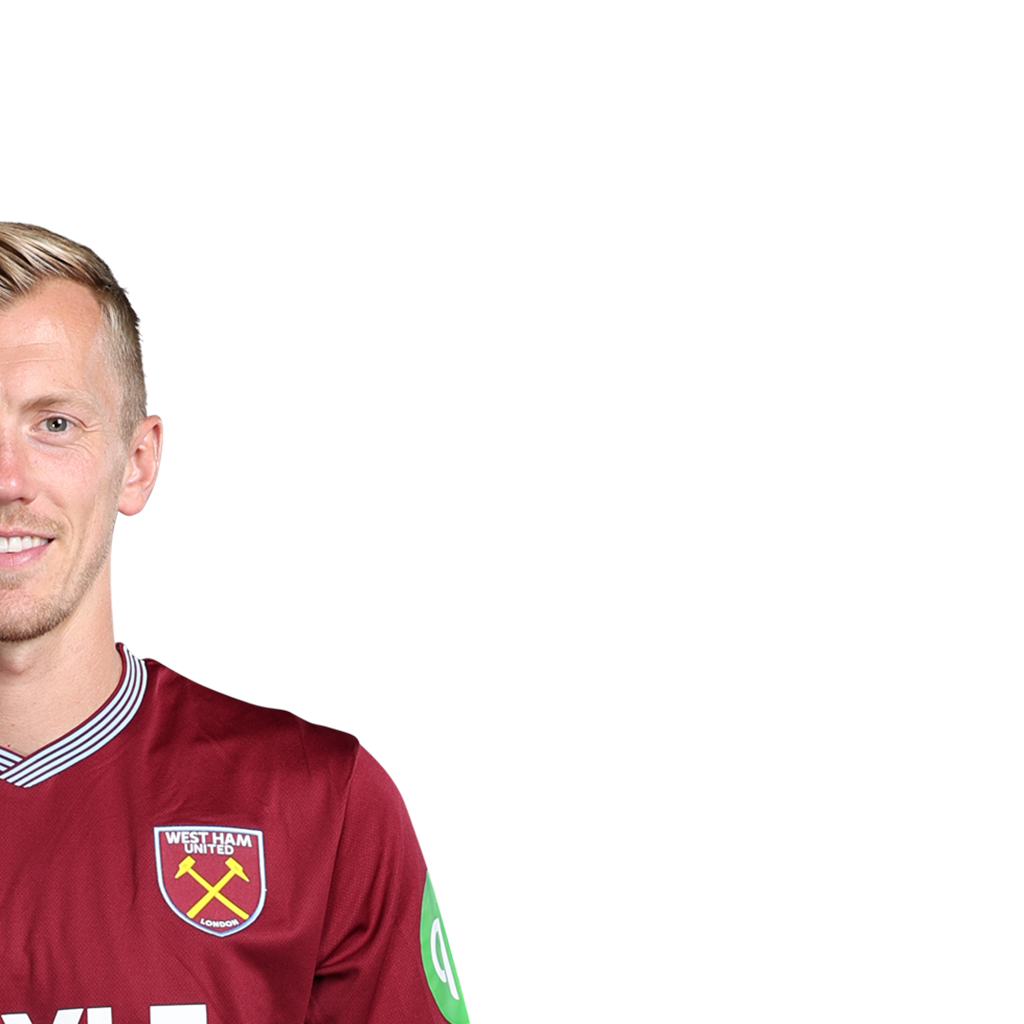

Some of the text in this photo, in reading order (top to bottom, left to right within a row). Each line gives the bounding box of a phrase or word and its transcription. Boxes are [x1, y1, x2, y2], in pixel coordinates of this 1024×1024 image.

[166, 832, 252, 847] WEST HAM
[184, 844, 234, 855] UNITED
[200, 918, 239, 928] LONDON
